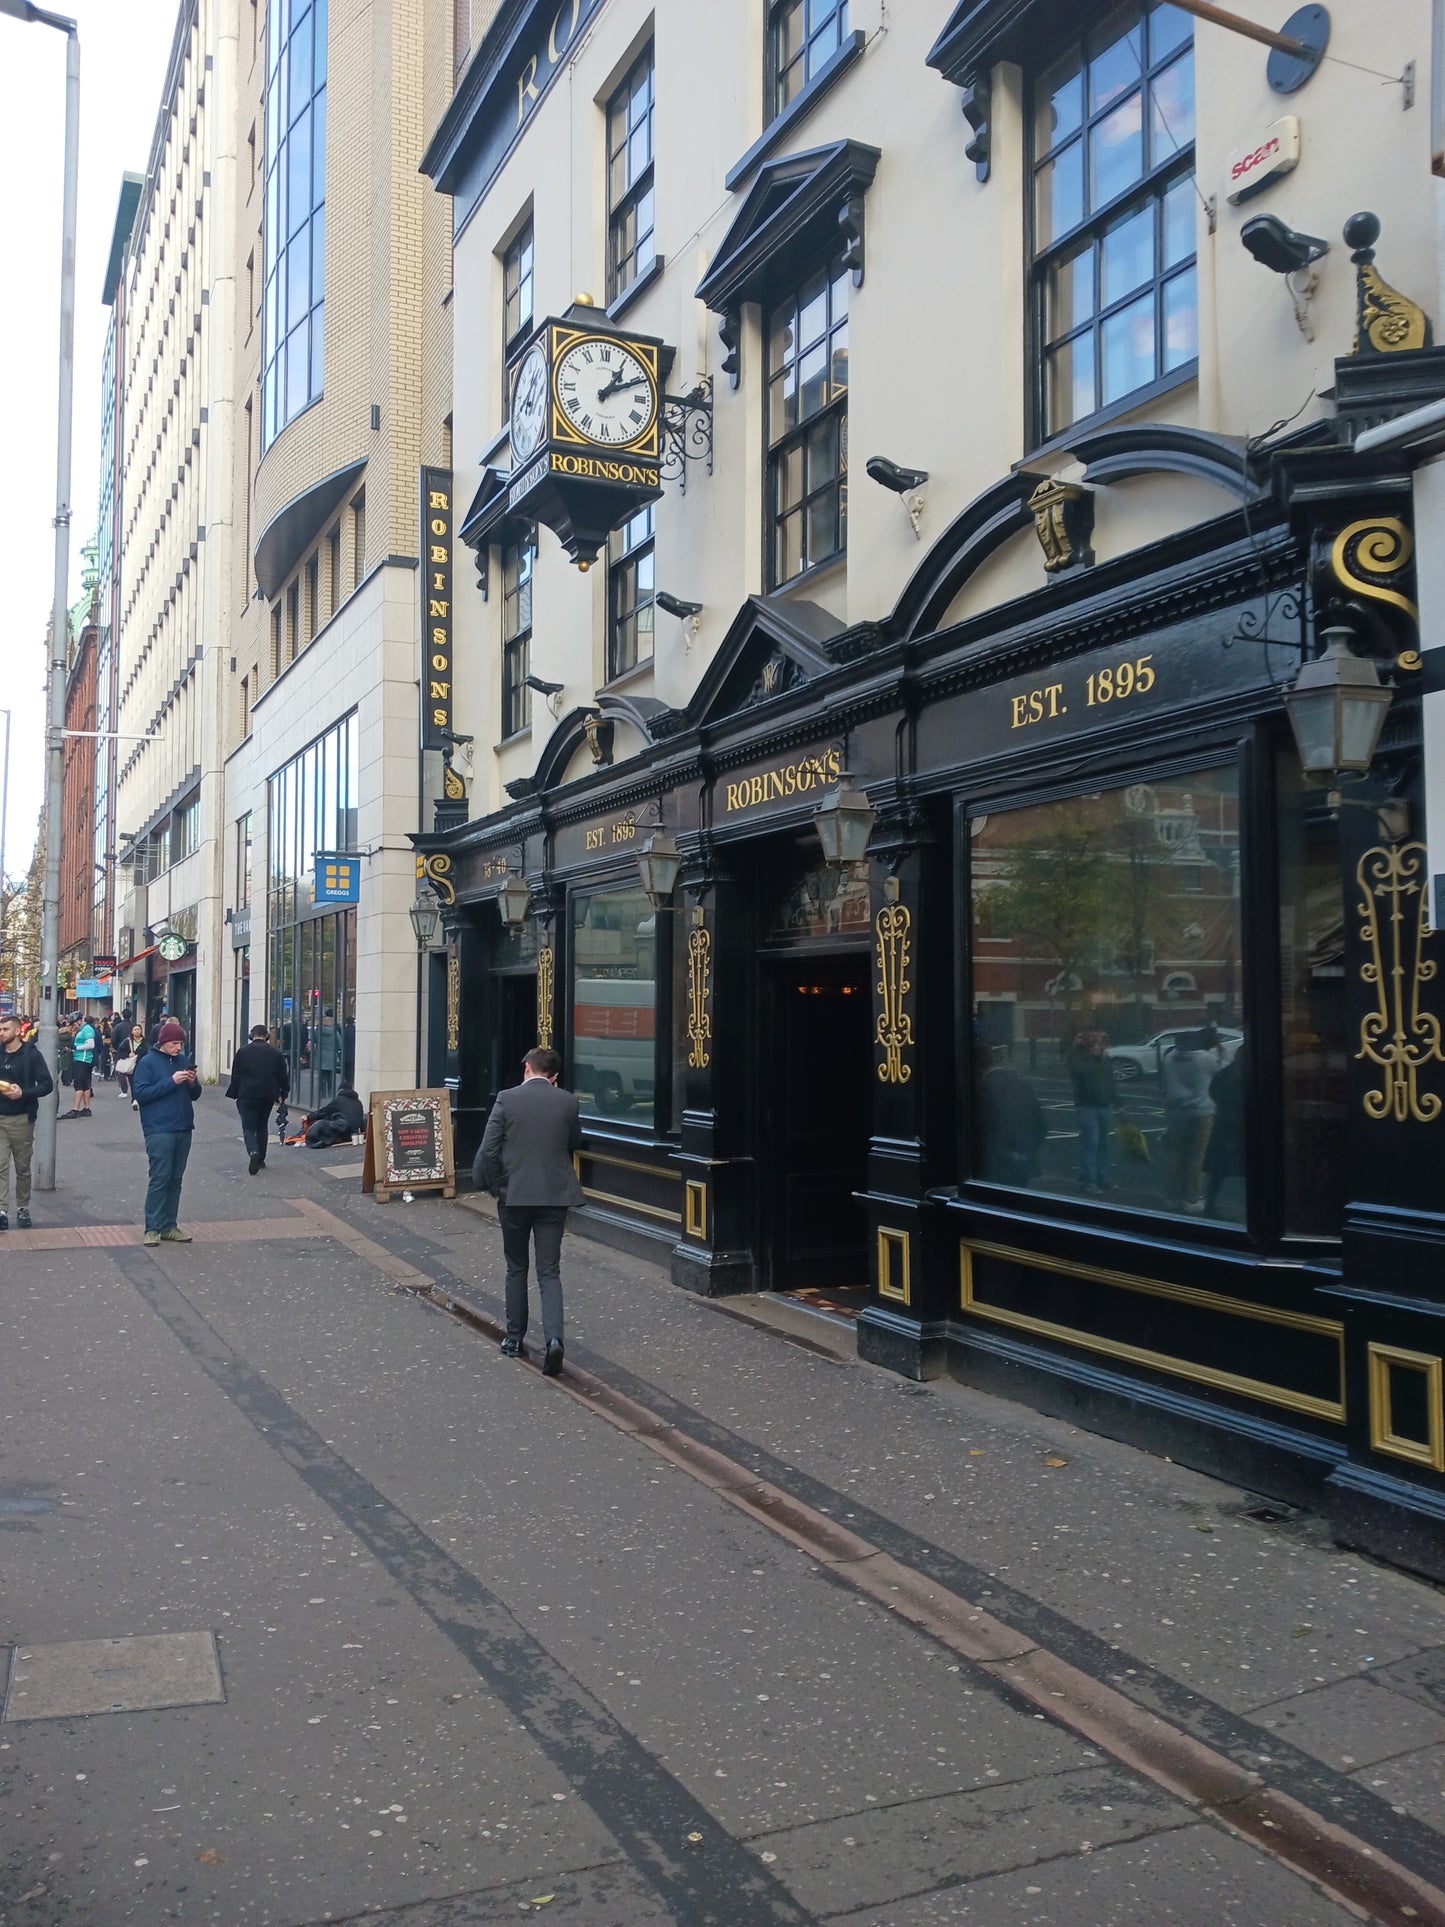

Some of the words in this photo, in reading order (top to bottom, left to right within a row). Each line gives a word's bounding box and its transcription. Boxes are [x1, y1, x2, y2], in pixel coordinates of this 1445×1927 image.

[517, 0, 594, 129] RO
[600, 349, 611, 363] XII
[634, 395, 647, 405] III
[551, 453, 659, 487] ROBINSON'S
[429, 491, 450, 727] ROBINSONS
[1011, 684, 1068, 729] EST.
[1086, 655, 1156, 707] 1895
[726, 748, 841, 812] ROBINSON'S
[586, 828, 606, 850] EST.
[611, 819, 636, 844] 1895
